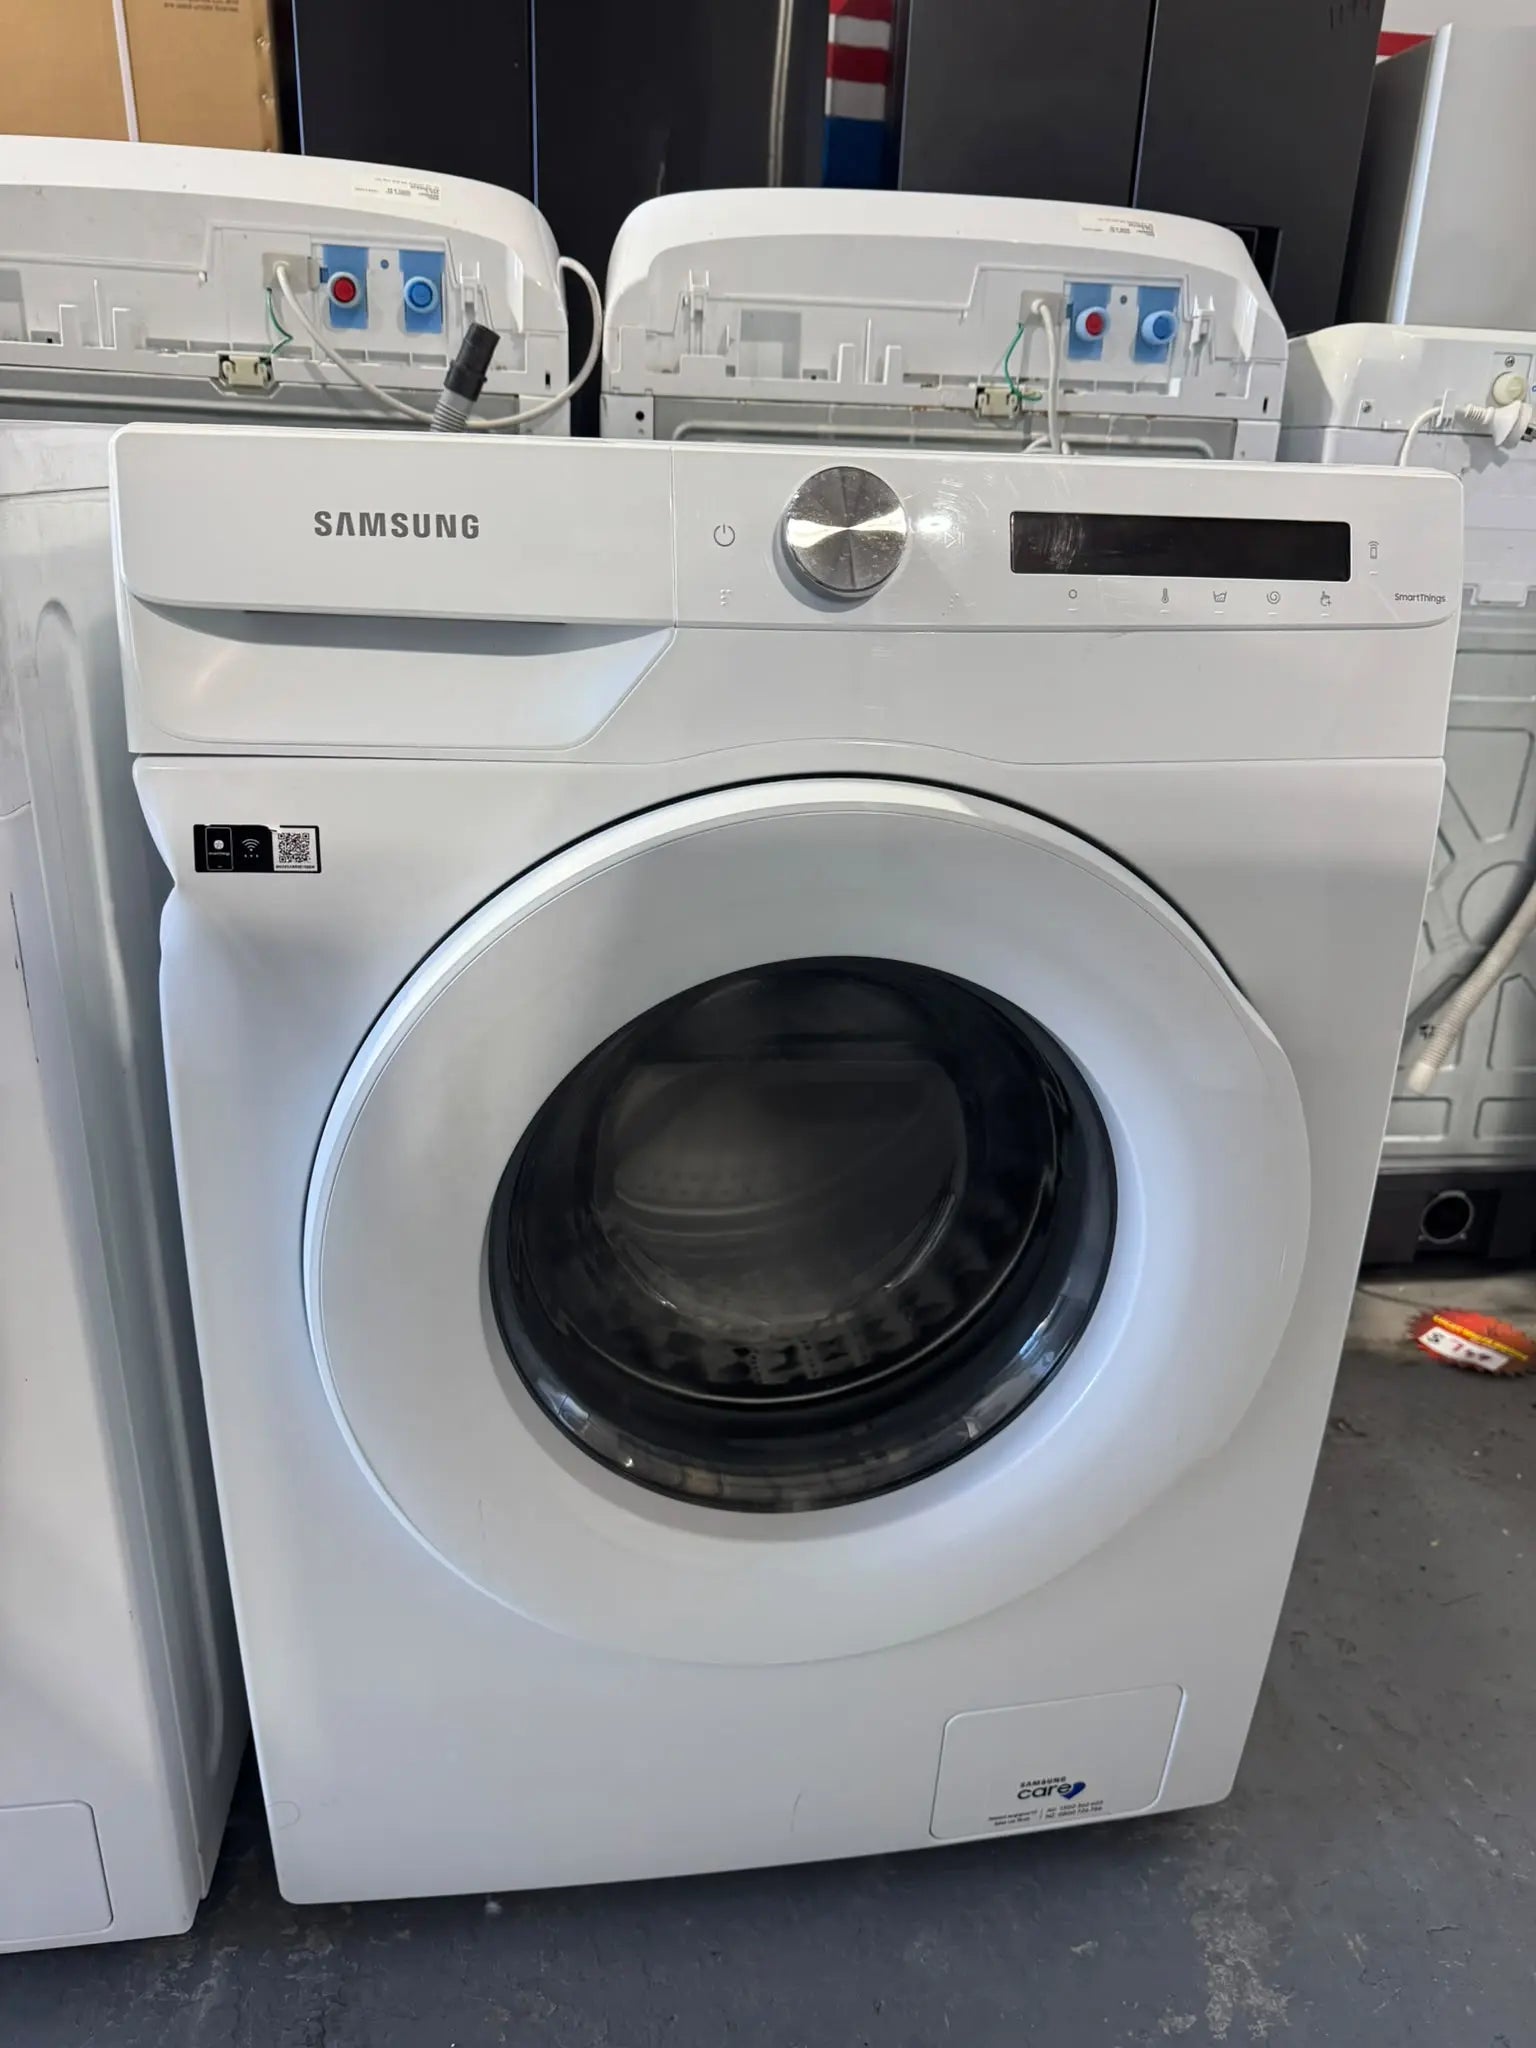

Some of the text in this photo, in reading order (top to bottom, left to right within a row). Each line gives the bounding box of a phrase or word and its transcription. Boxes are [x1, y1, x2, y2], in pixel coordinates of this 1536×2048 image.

[314, 511, 480, 539] SAMSUNG
[1394, 593, 1447, 604] SmartThings
[1020, 1776, 1067, 1788] SAMSUNG
[1017, 1783, 1072, 1800] care
